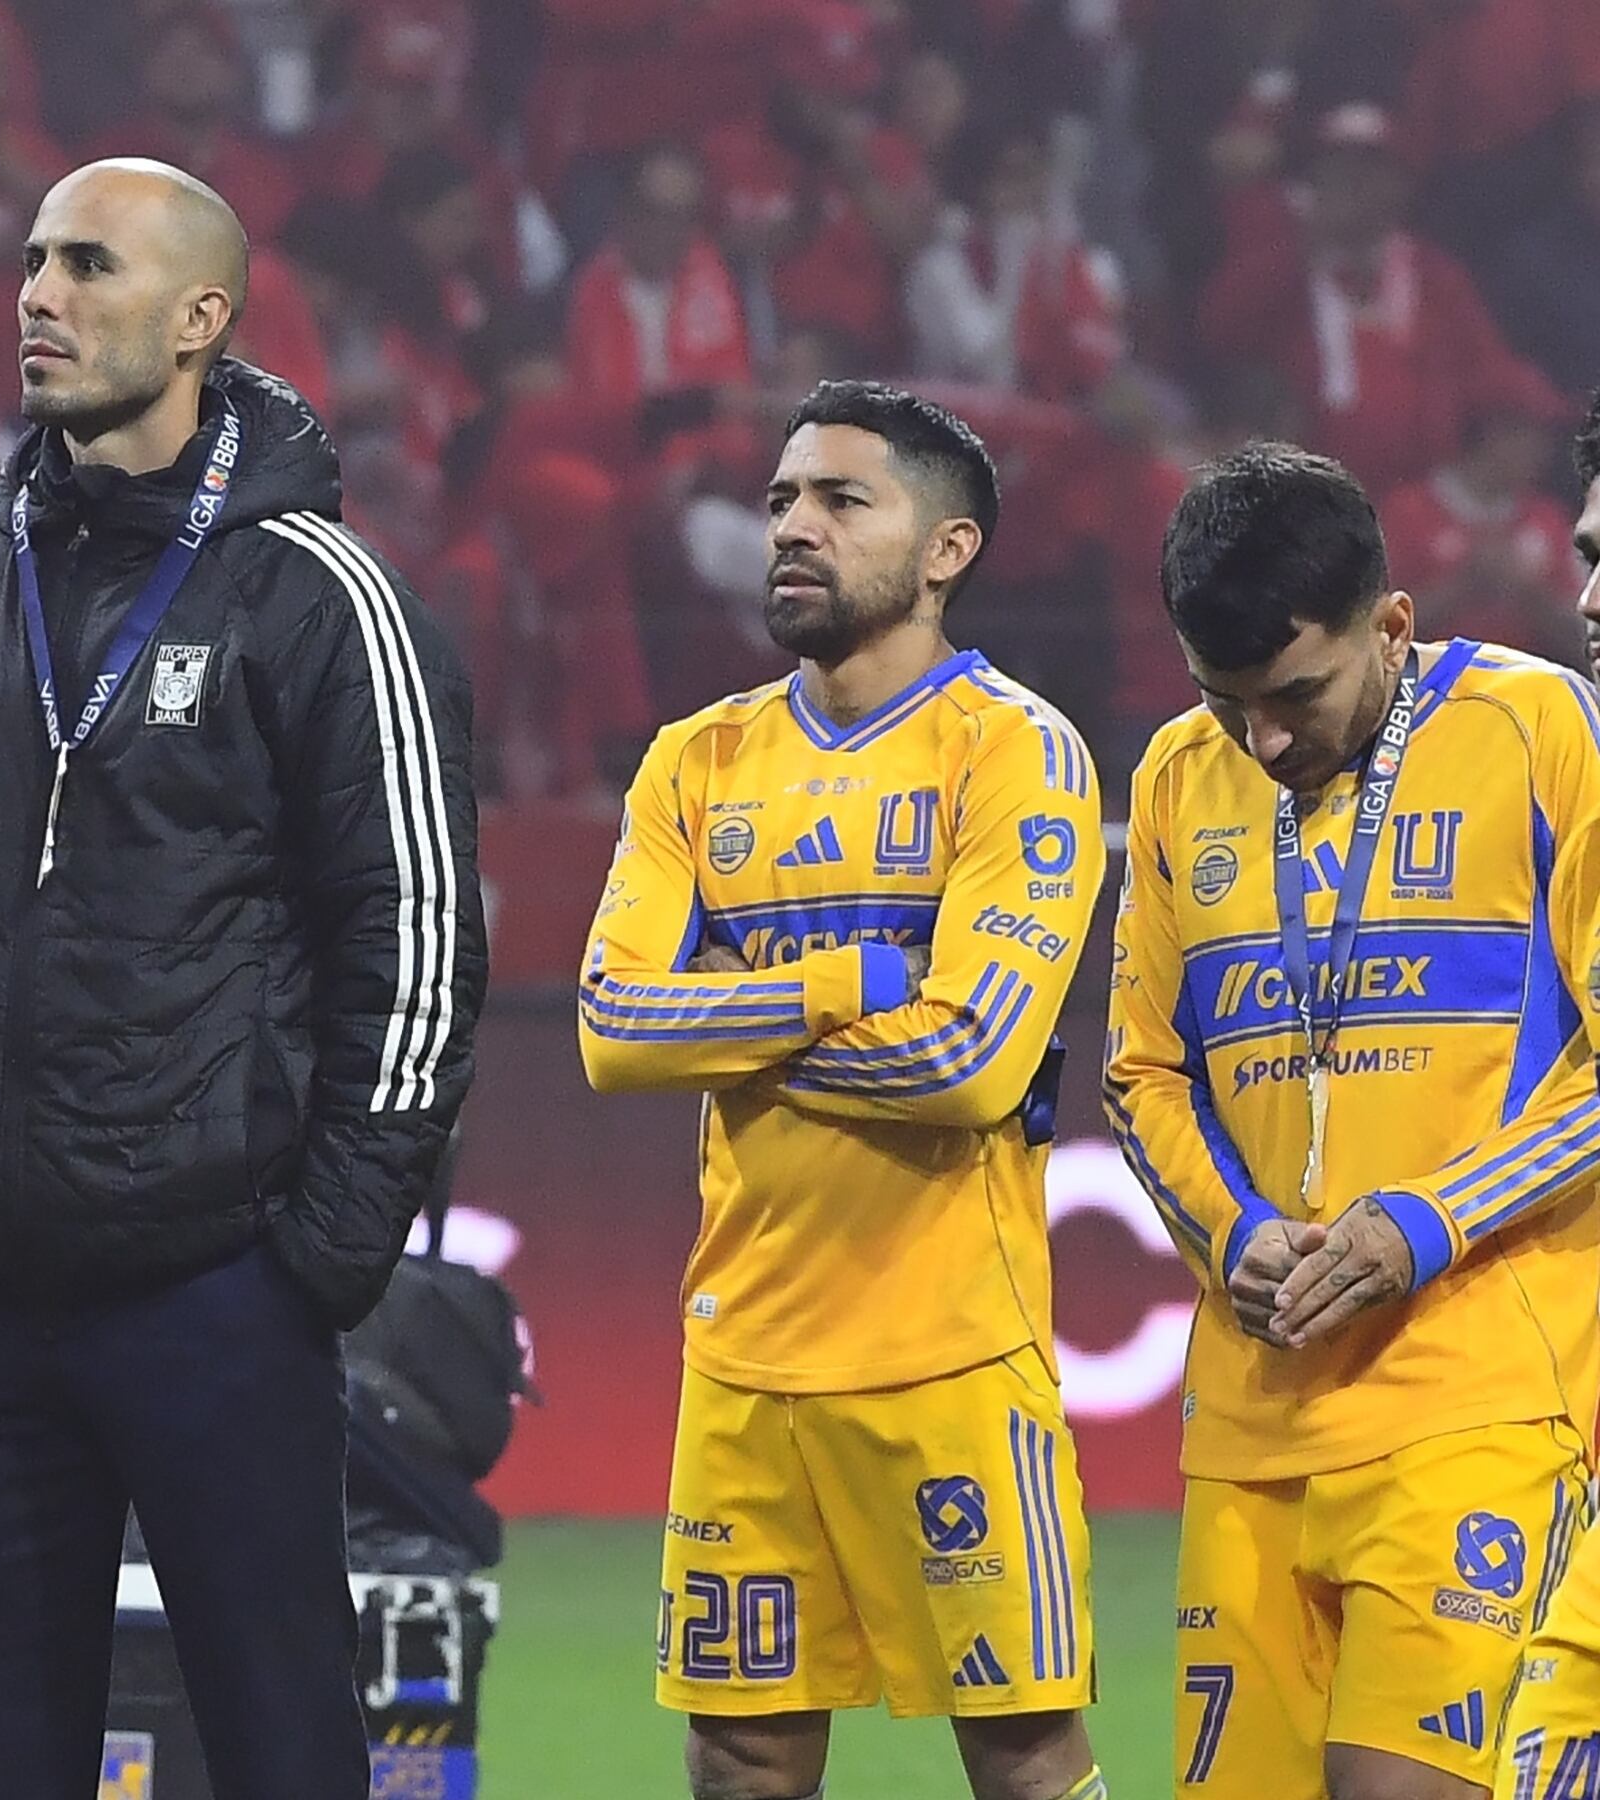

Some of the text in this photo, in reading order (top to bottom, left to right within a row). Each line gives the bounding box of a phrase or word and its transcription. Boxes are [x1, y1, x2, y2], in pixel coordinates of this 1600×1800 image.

[177, 413, 240, 549] LIGA BBVA
[12, 484, 29, 554] LIGA
[159, 646, 209, 662] TIGRES
[74, 673, 118, 741] BBVA
[1357, 677, 1416, 835] LIGA BBVA
[1277, 800, 1299, 860] LIGA
[1393, 811, 1463, 887] U
[972, 903, 1071, 963] telcel
[1231, 1046, 1435, 1101] SPORUMBET
[955, 1558, 1002, 1578] GAS
[682, 1569, 796, 1680] 20
[1482, 1604, 1523, 1635] GAS
[1185, 1664, 1234, 1784] 7
